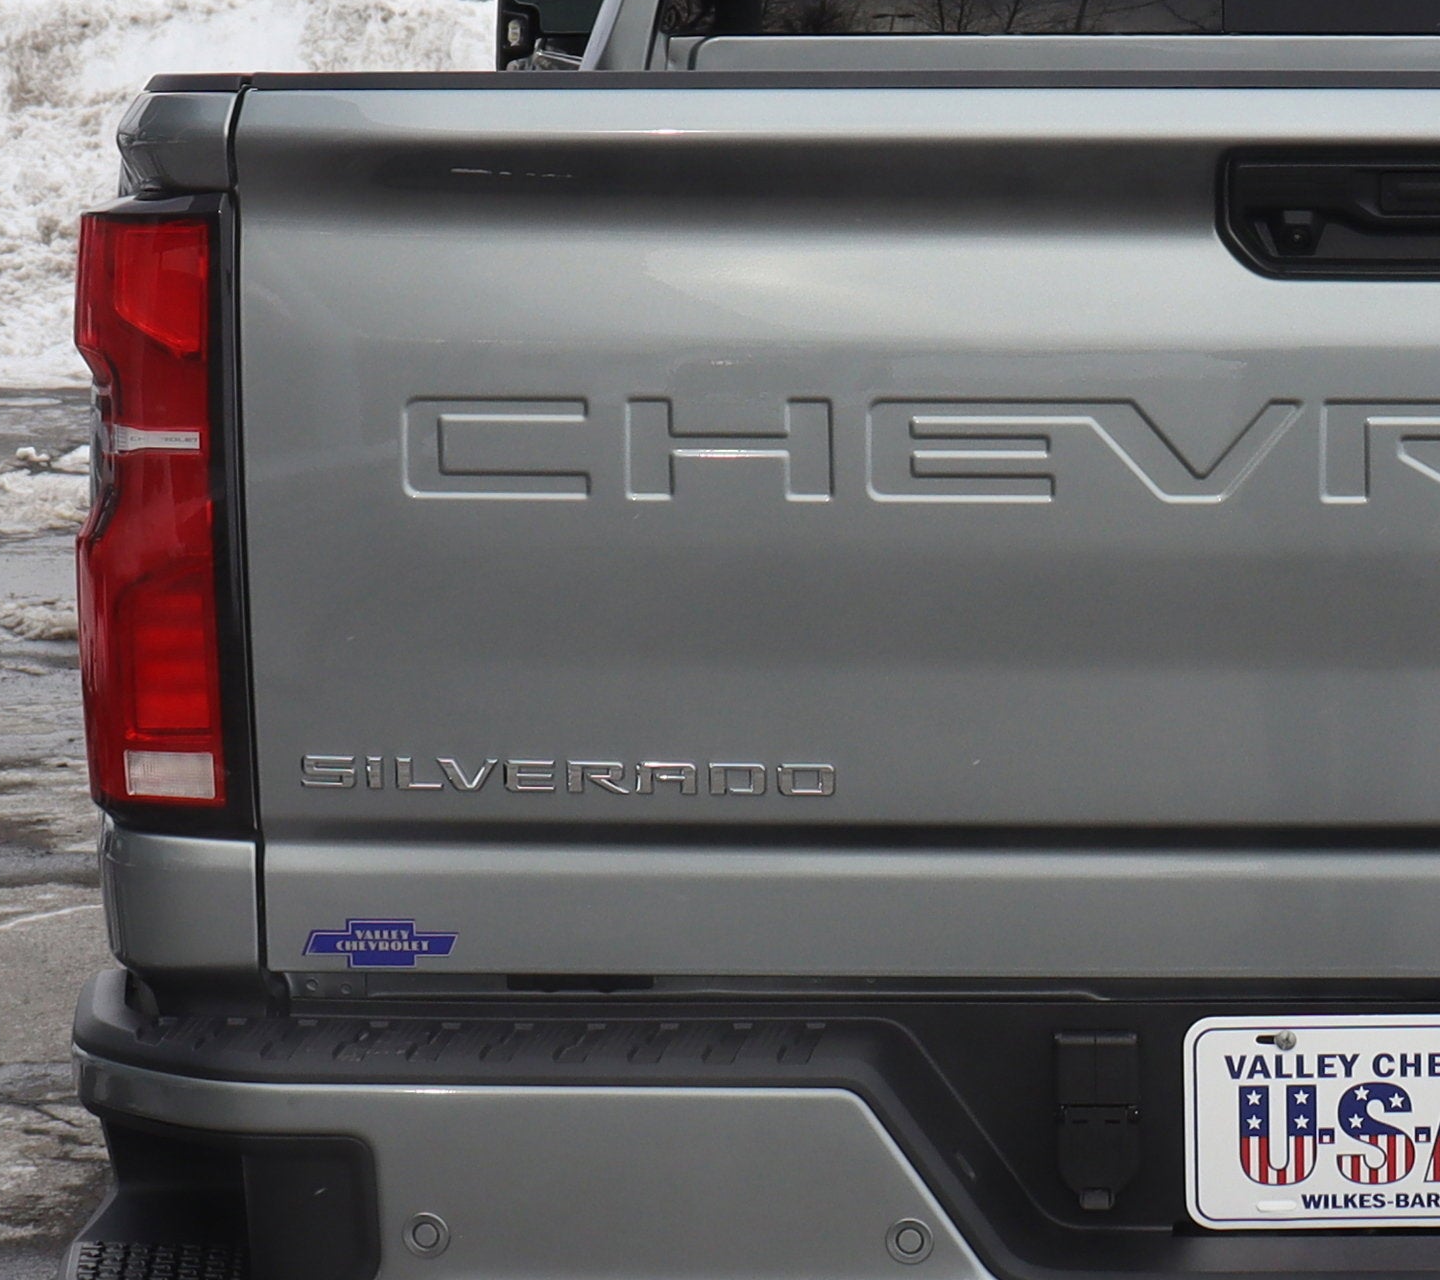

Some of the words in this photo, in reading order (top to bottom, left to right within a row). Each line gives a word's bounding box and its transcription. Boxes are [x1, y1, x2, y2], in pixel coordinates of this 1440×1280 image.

[300, 754, 837, 796] SILVERADO
[355, 930, 409, 939] VALLEY
[336, 940, 429, 951] CHEVROLET
[1224, 1053, 1359, 1080] VALLEY
